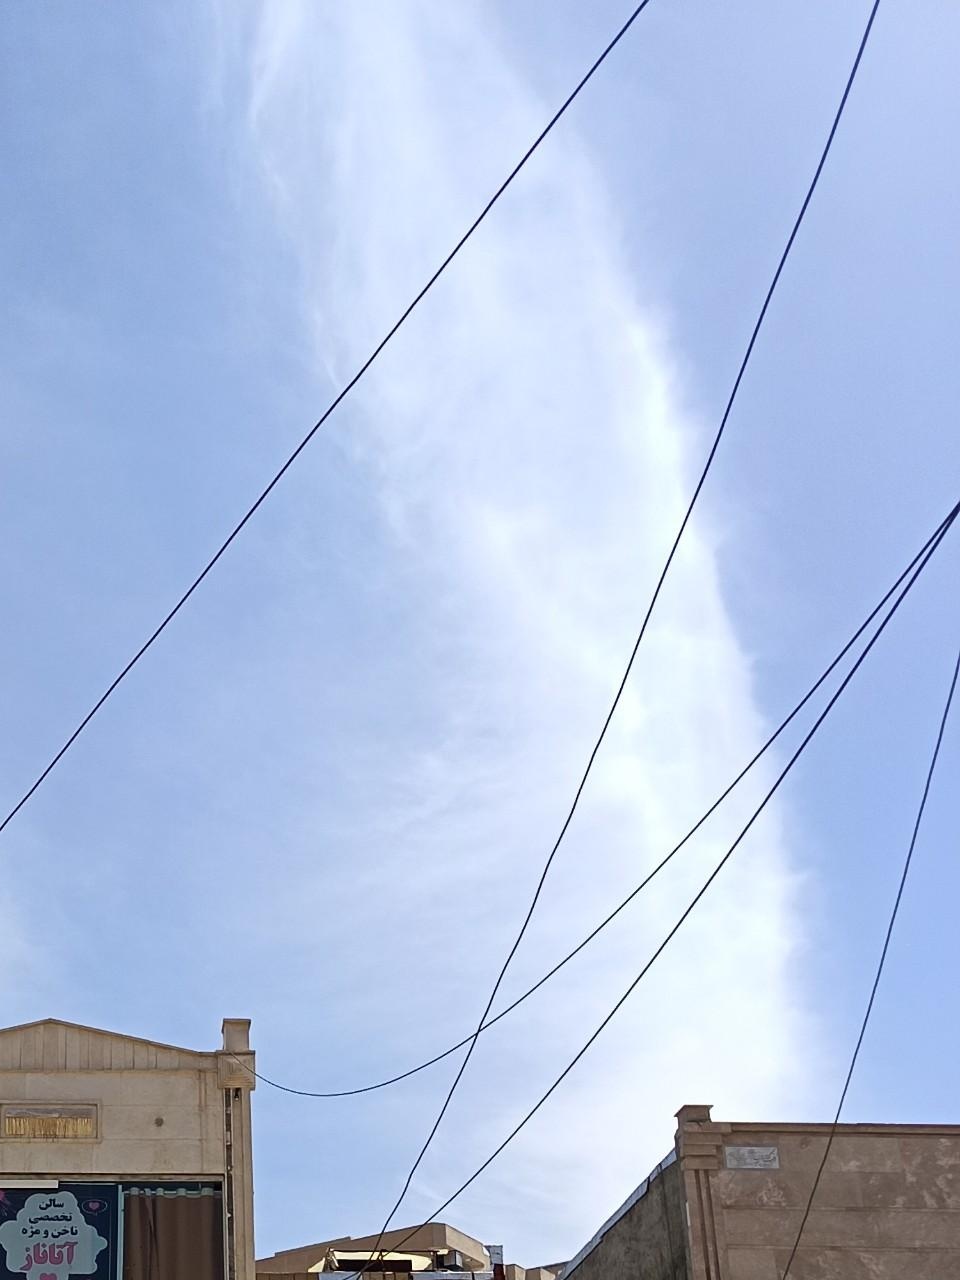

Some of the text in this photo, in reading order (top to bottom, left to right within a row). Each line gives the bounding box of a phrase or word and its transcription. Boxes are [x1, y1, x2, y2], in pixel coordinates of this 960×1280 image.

[39, 1198, 65, 1210] سالن
[28, 1213, 72, 1224] تخصصی
[21, 1226, 78, 1238] ناخن و مژه
[20, 1241, 78, 1271] آتاناز
